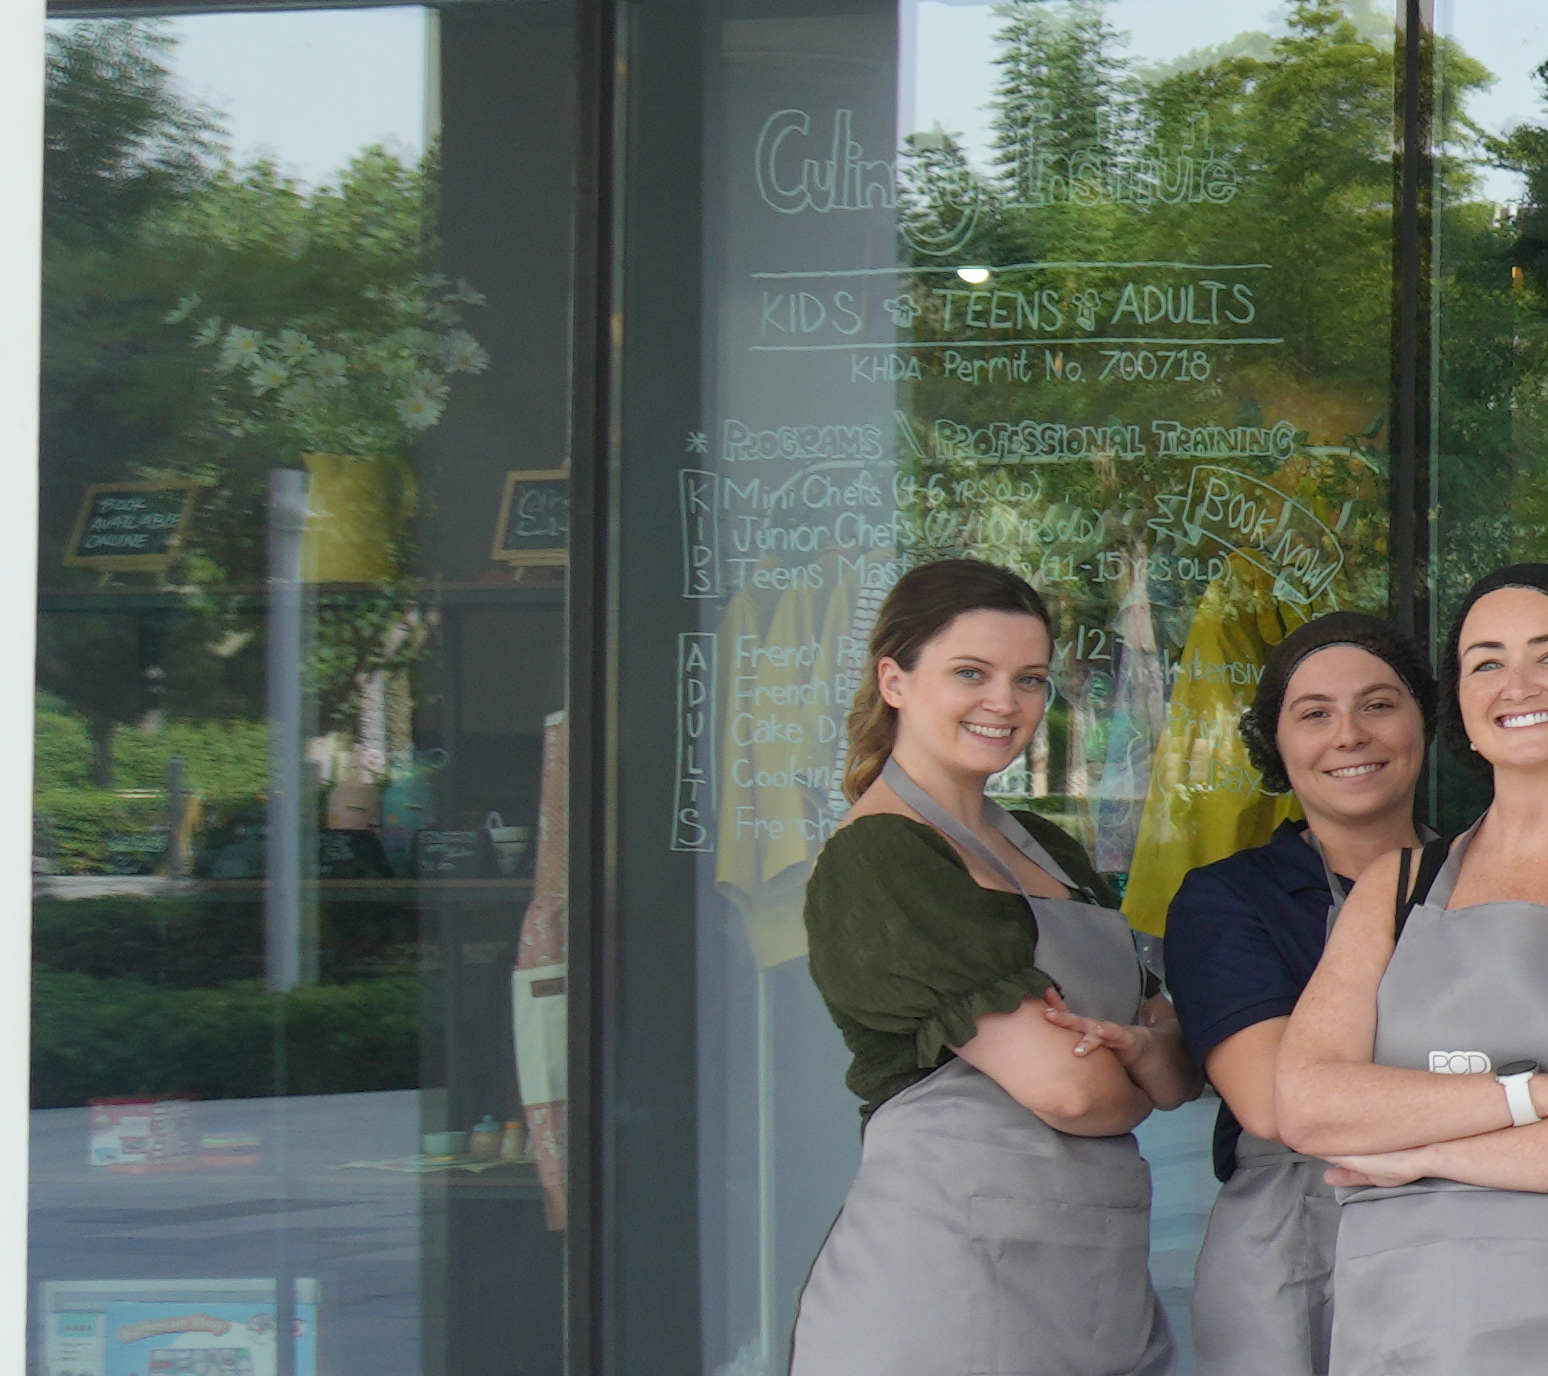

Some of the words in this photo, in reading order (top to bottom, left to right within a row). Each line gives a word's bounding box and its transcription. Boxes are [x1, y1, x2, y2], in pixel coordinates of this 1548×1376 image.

[761, 289, 862, 336] KIDS
[933, 289, 1066, 331] TEENS
[1111, 280, 1256, 326] ADULTS
[850, 351, 922, 384] KHDA
[944, 350, 1034, 384] Permit
[1045, 350, 1087, 384] No.
[1099, 350, 1212, 382] 700718
[724, 419, 883, 462] PROGRAMS
[935, 419, 1146, 459] PROFESSIONAL
[1152, 420, 1297, 460] TRAINING
[723, 477, 795, 512] Mini
[802, 470, 882, 506] Chefs
[834, 511, 916, 549] Chefs
[1203, 476, 1277, 552] BOOK
[1272, 528, 1340, 592] NOW
[726, 557, 825, 592] Teens
[735, 634, 823, 669] French
[1163, 647, 1266, 685] Intensiv
[734, 674, 831, 711] French
[731, 711, 804, 747] Cake
[732, 754, 832, 790] Cookin
[1433, 1054, 1488, 1075] PCD
